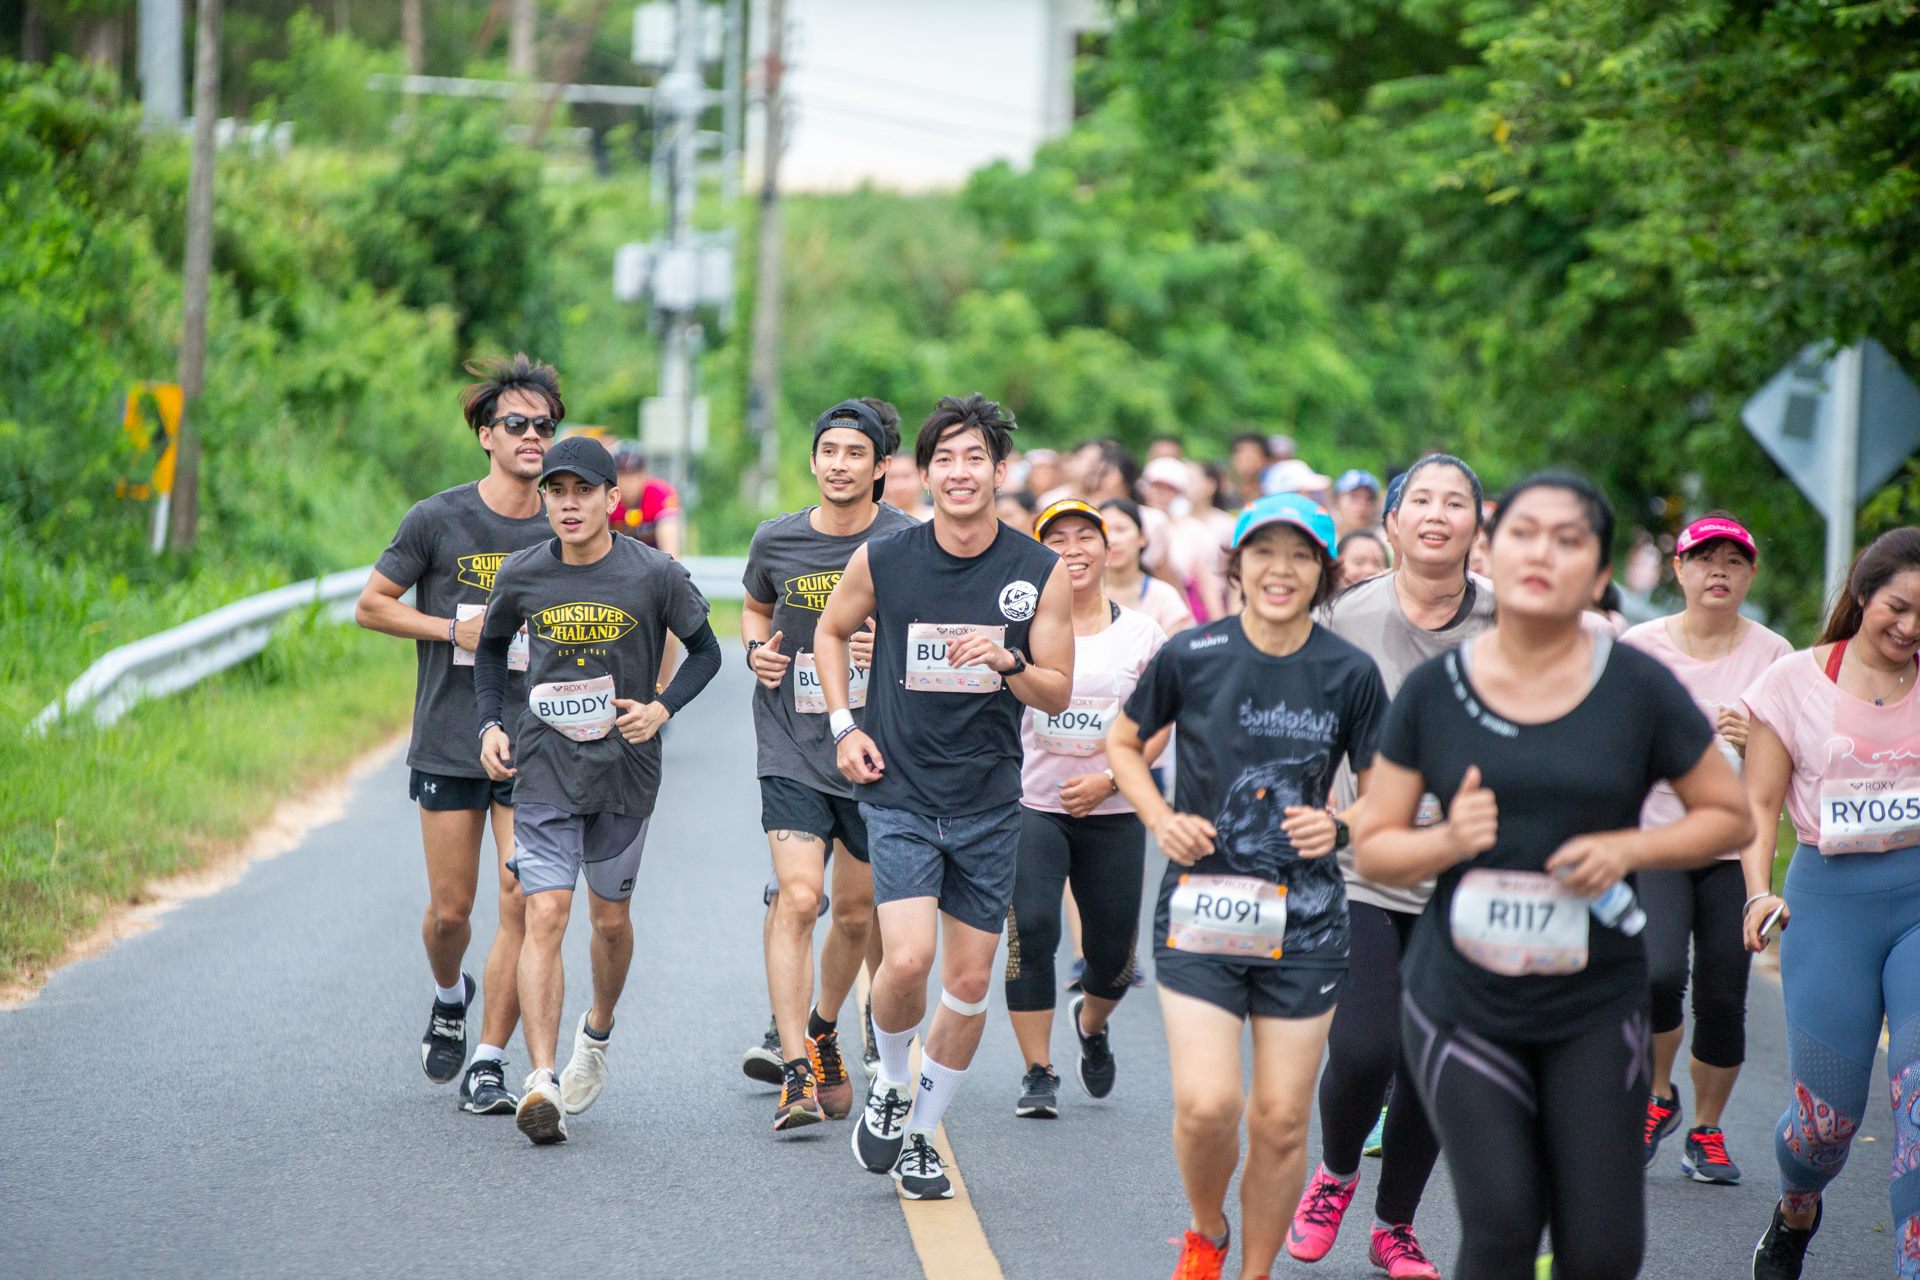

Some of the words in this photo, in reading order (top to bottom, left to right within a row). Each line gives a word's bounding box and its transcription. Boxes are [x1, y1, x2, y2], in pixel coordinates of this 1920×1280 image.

[542, 606, 624, 625] QUIKSILVER
[551, 624, 620, 641] THAILAND
[1189, 634, 1229, 650] SUUNTO
[563, 683, 588, 692] ROXY
[538, 694, 609, 717] BUDDY
[1047, 712, 1102, 731] R094
[1248, 727, 1263, 736] DO
[1264, 727, 1285, 737] NOT
[1865, 781, 1896, 791] ROXY
[1831, 797, 1920, 824] RY065
[1194, 894, 1262, 925] R091
[1488, 900, 1557, 933] R117
